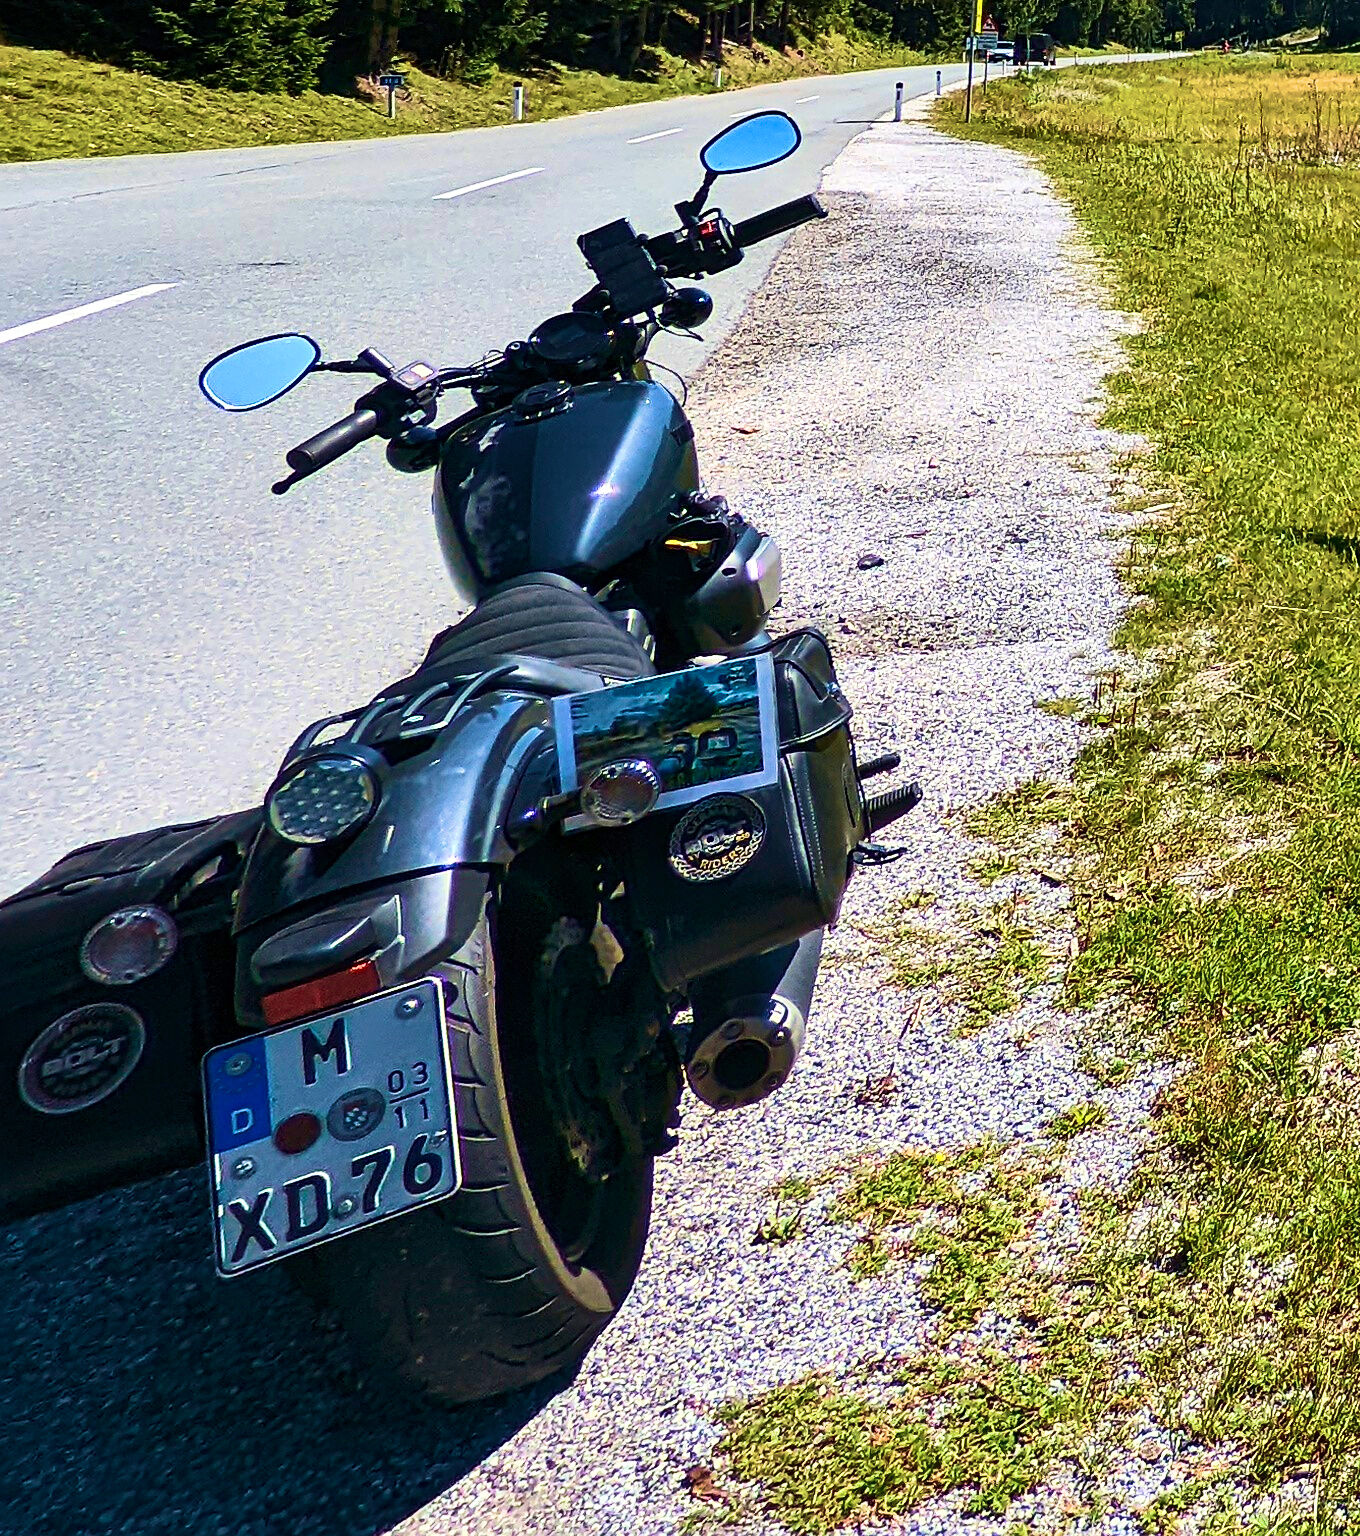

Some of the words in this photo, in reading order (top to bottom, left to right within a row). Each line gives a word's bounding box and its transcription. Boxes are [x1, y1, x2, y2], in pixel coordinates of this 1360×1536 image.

[699, 844, 745, 870] RIDERS
[301, 1017, 352, 1087] M
[387, 1061, 430, 1094] 03
[230, 1107, 254, 1135] D
[393, 1097, 431, 1129] 11
[227, 1170, 334, 1264] XD
[351, 1133, 444, 1215] 76
